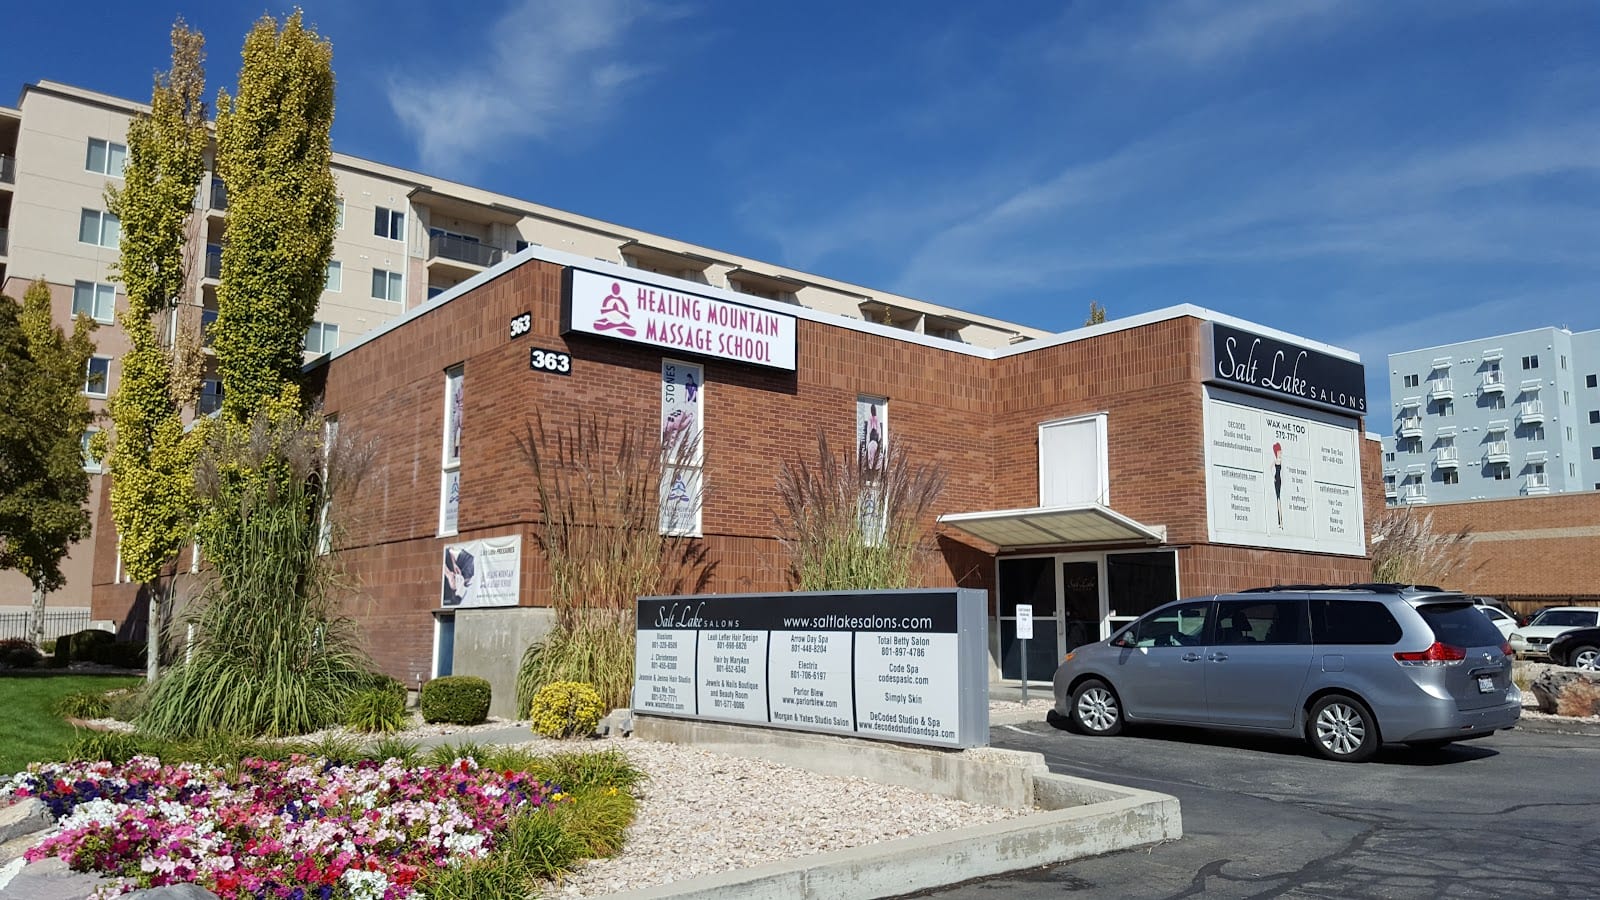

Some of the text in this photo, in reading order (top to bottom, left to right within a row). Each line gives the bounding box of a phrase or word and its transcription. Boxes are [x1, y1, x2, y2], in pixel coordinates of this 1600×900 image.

[637, 287, 778, 337] HEALING MOUNTAIN
[510, 315, 531, 337] 363
[646, 317, 771, 362] MASSAGE SCHOOL
[532, 350, 570, 372] 363
[1218, 336, 1365, 410] Salt Lake SALONS
[666, 365, 675, 403] STONES
[1266, 419, 1305, 434] WAX ME TOO
[655, 602, 740, 628] Salt Lake SALONS
[783, 614, 932, 629] www.saltlakesalons.com
[742, 634, 758, 643] Design
[790, 634, 828, 644] Arrow Day Spa
[877, 635, 930, 647] Total Betty Salon
[881, 647, 925, 657] 801-897-4786
[889, 663, 919, 675] Code Spa
[726, 680, 737, 688] Nails
[738, 681, 758, 690] Boutique
[878, 674, 929, 685] codespaslc.com
[720, 689, 734, 699] Beauty
[735, 691, 748, 699] Room
[793, 687, 809, 696] Parlor
[885, 692, 922, 704] Simply Skin
[774, 711, 849, 727] Morgan & Yates Studio Salon
[870, 711, 941, 728] DeCoded Studio & Spa
[859, 722, 955, 739] www.decodedstudioandspa.com
